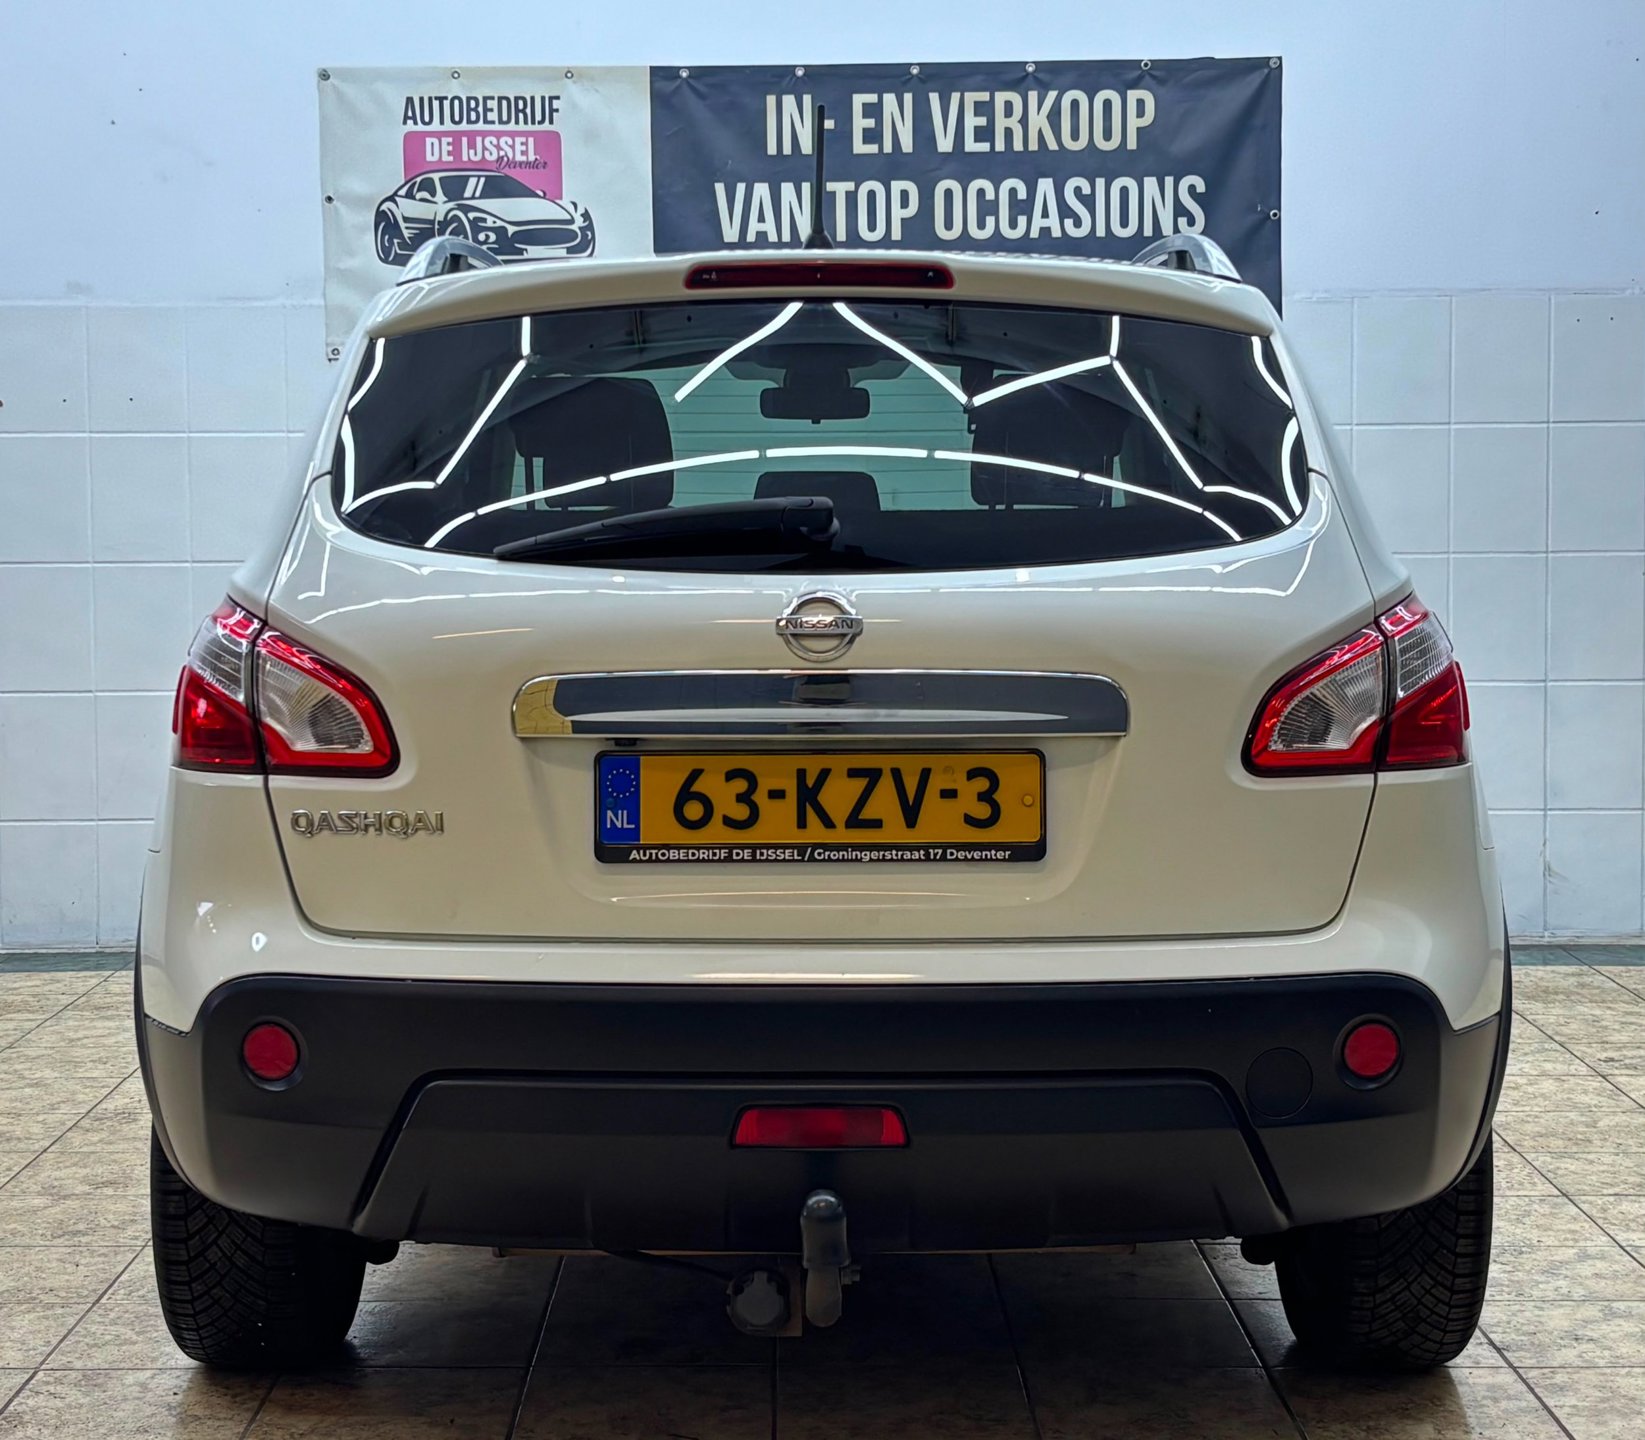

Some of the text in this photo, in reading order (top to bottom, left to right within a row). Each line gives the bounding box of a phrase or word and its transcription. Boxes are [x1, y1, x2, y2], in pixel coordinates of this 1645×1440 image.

[402, 95, 561, 126] AUTOBEDRIJF
[852, 92, 914, 155] EN
[929, 89, 1156, 154] VERKOOP
[425, 136, 540, 162] DE IJSSEL
[495, 155, 549, 171] Deventer
[714, 175, 1207, 243] VAN TOP OCCASIONS
[785, 618, 854, 630] NISSAN
[673, 767, 1002, 830] 63-KZV-3
[290, 808, 445, 839] QASHQAI
[606, 810, 635, 829] NL
[629, 847, 1012, 862] AUTOBEDRIJF DE IJSSEL / Groningerstraat 17 Deventer
